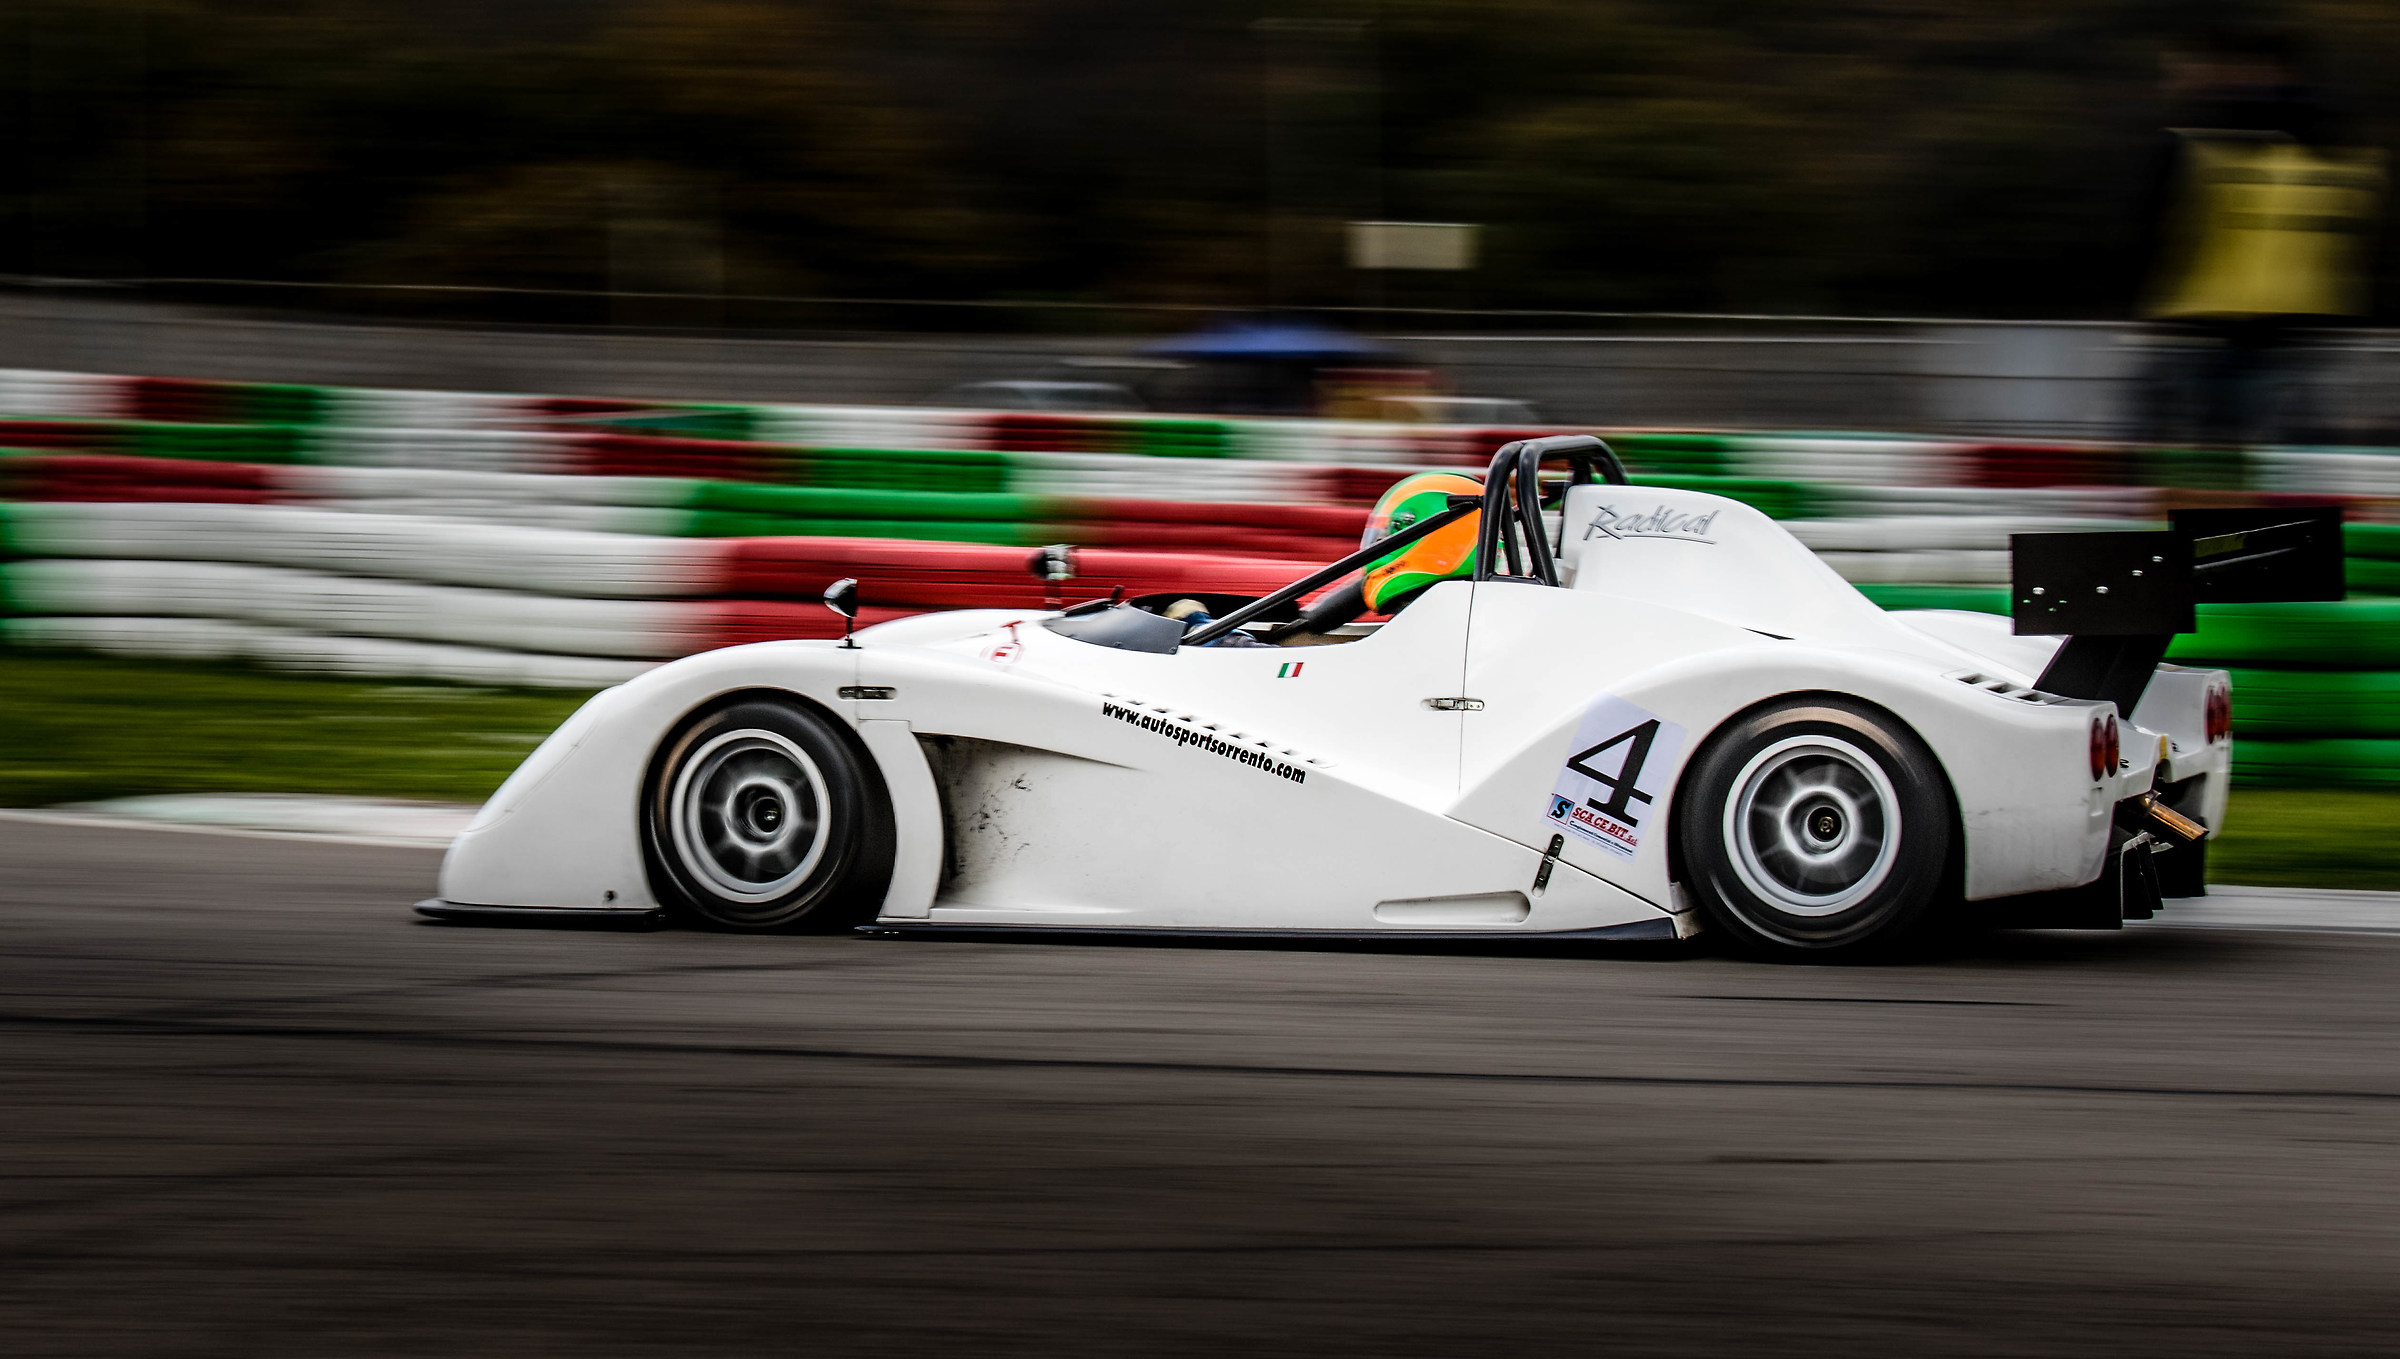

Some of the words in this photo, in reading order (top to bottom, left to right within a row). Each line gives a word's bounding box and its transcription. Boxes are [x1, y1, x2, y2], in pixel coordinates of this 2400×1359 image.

[1582, 504, 1721, 541] Radical
[1102, 702, 1306, 784] www.autosportsorrento.com
[1566, 718, 1661, 828] 4
[1551, 800, 1571, 819] S
